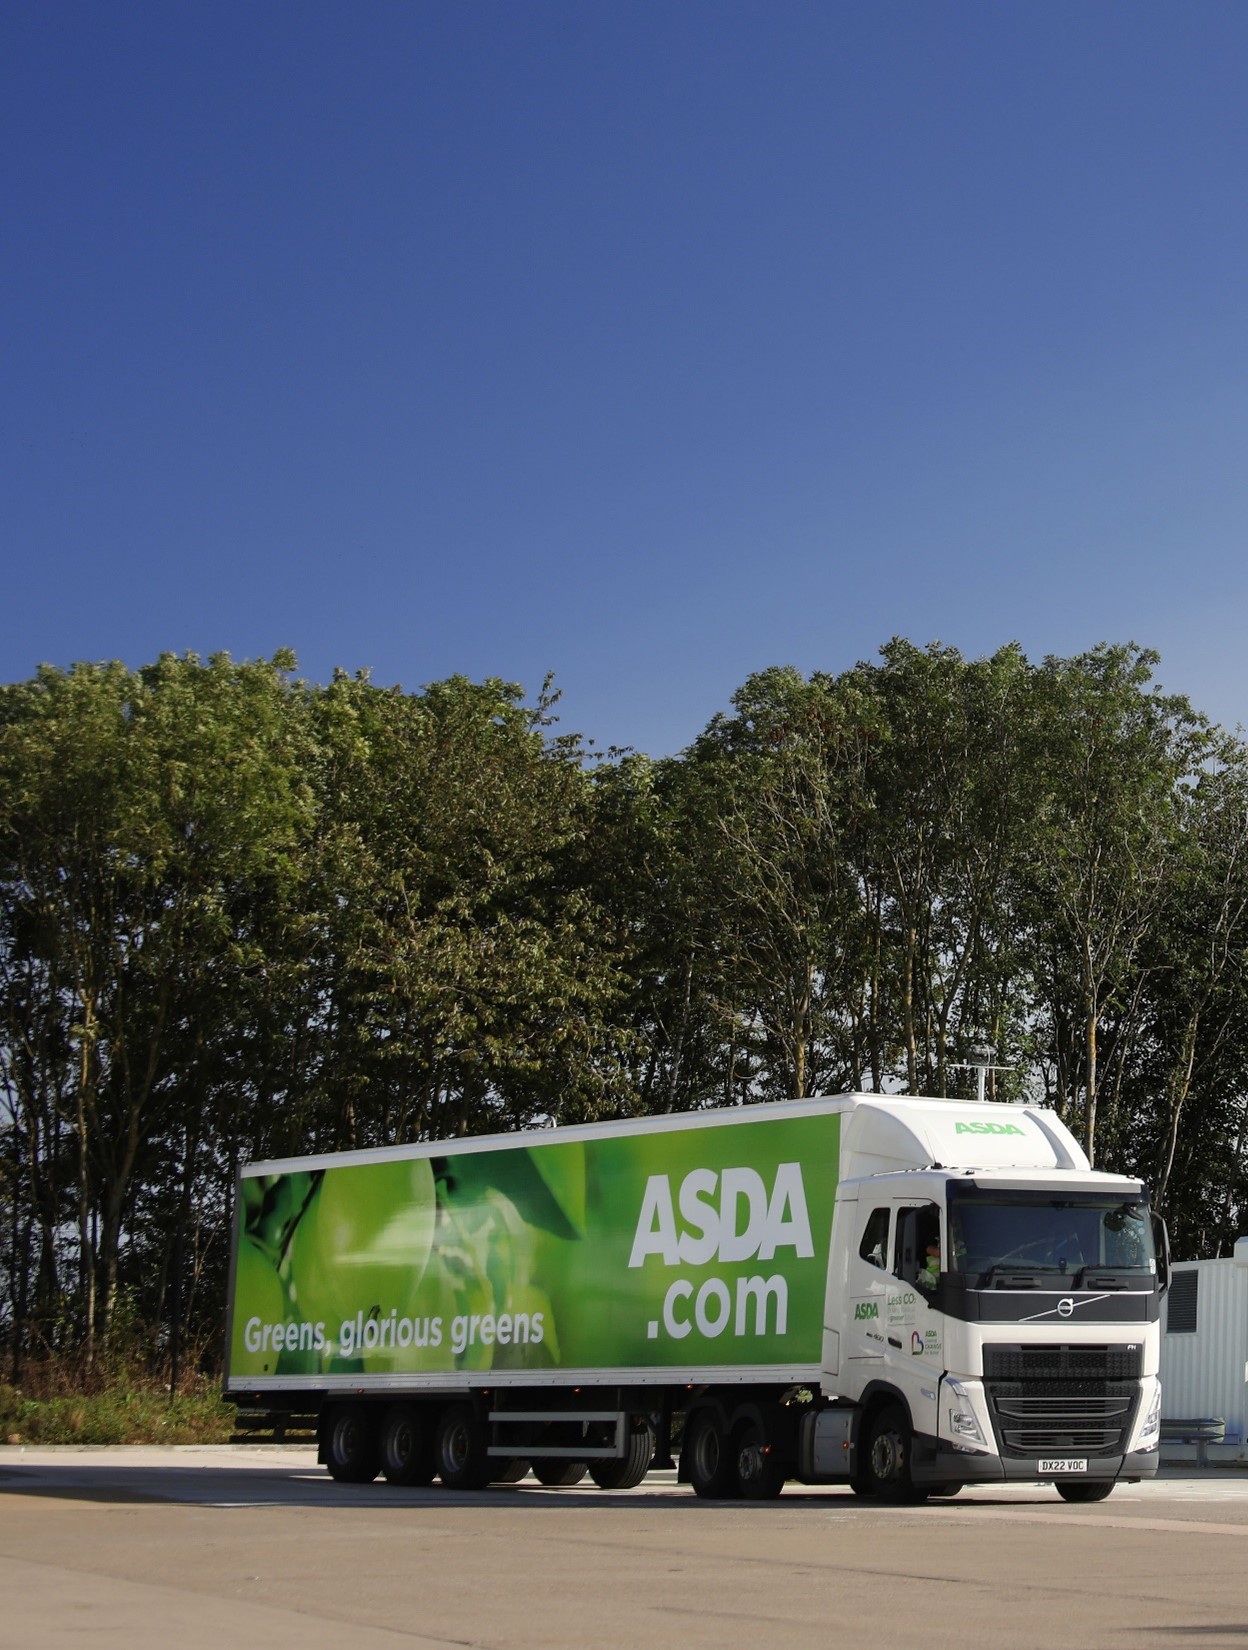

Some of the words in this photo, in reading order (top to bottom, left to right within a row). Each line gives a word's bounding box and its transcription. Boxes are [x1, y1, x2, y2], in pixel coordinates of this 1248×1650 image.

[955, 1122, 1027, 1136] ASDA
[628, 1162, 815, 1268] ASDA
[647, 1274, 788, 1339] .com
[854, 1302, 879, 1320] ASDA
[245, 1316, 331, 1357] Greens,
[339, 1308, 443, 1357] glorious
[451, 1311, 544, 1354] greens
[1042, 1461, 1066, 1470] DX22
[1068, 1461, 1084, 1470] VOC
